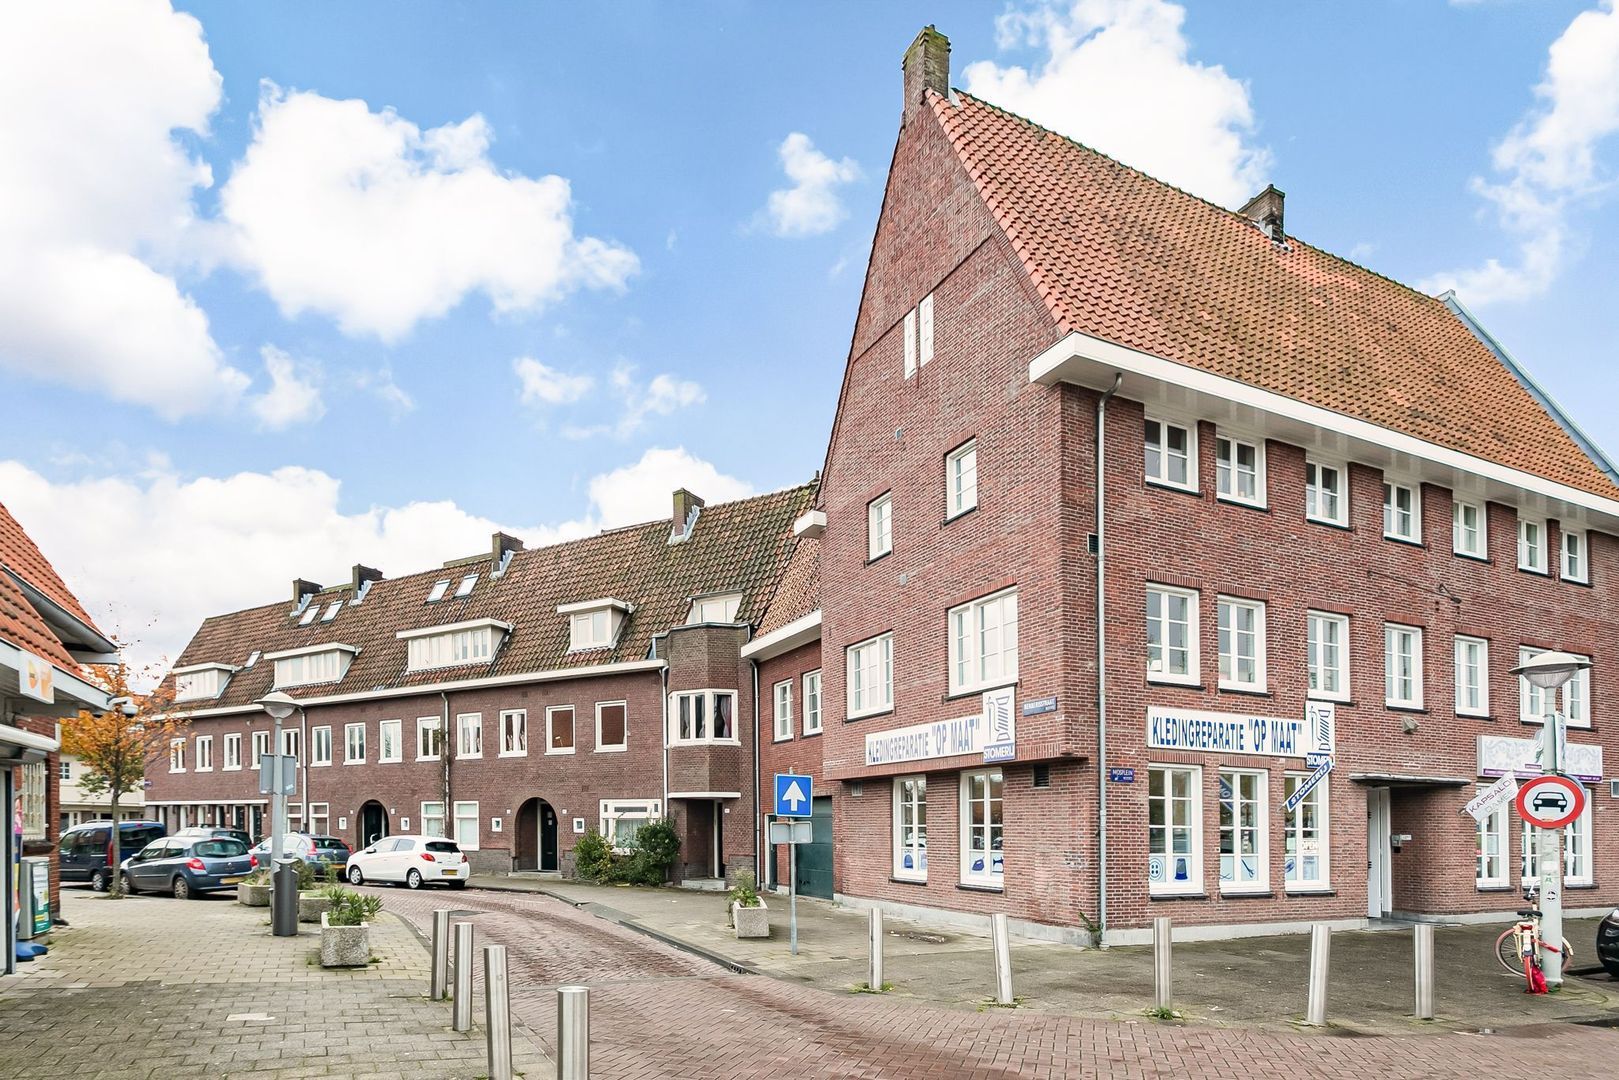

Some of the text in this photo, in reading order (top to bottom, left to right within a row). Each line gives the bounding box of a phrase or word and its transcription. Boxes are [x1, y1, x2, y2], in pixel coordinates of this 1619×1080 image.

[868, 718, 980, 763] KLEDINGREPARATIE "OP MAAT"
[984, 744, 1015, 760] STOMERIJ
[1152, 716, 1302, 754] KLEDINGREPARATIE "OP MAAT"
[1290, 764, 1329, 805] STOMERIJ
